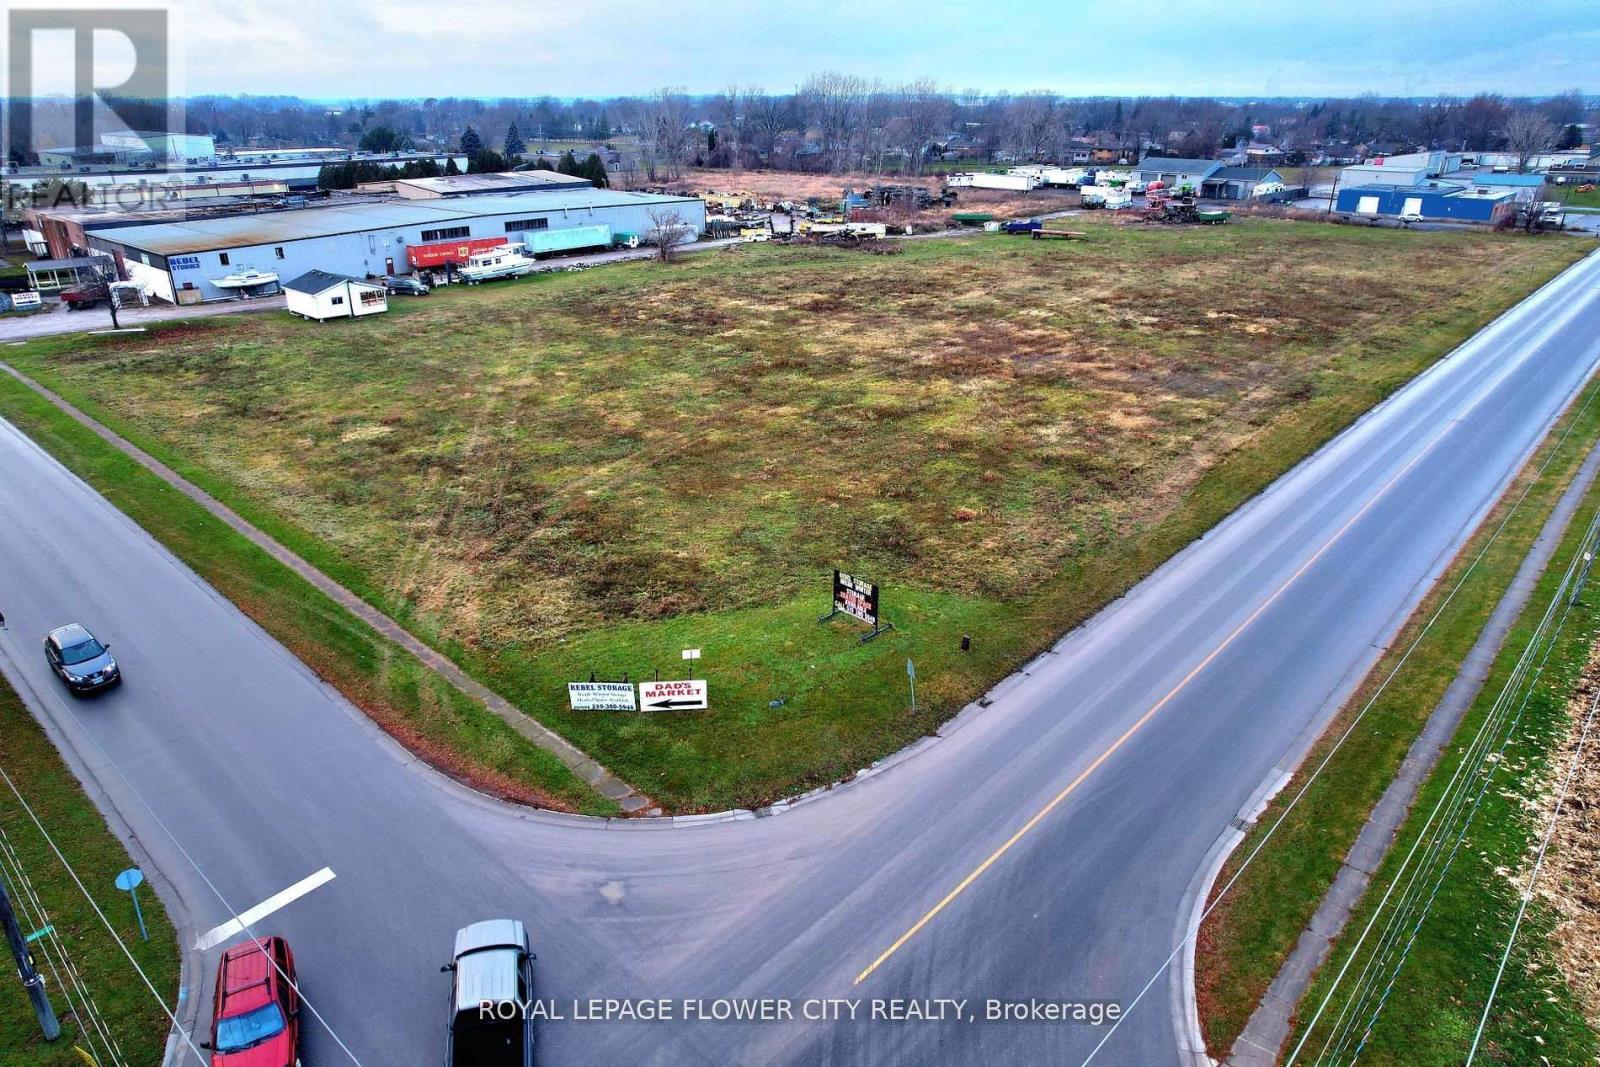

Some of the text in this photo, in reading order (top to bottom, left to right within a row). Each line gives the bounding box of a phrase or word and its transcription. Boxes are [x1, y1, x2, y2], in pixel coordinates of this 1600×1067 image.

[170, 257, 200, 265] REBEL
[597, 684, 632, 692] STORAGE
[655, 682, 692, 691] DAD'S
[645, 688, 702, 698] MARKET
